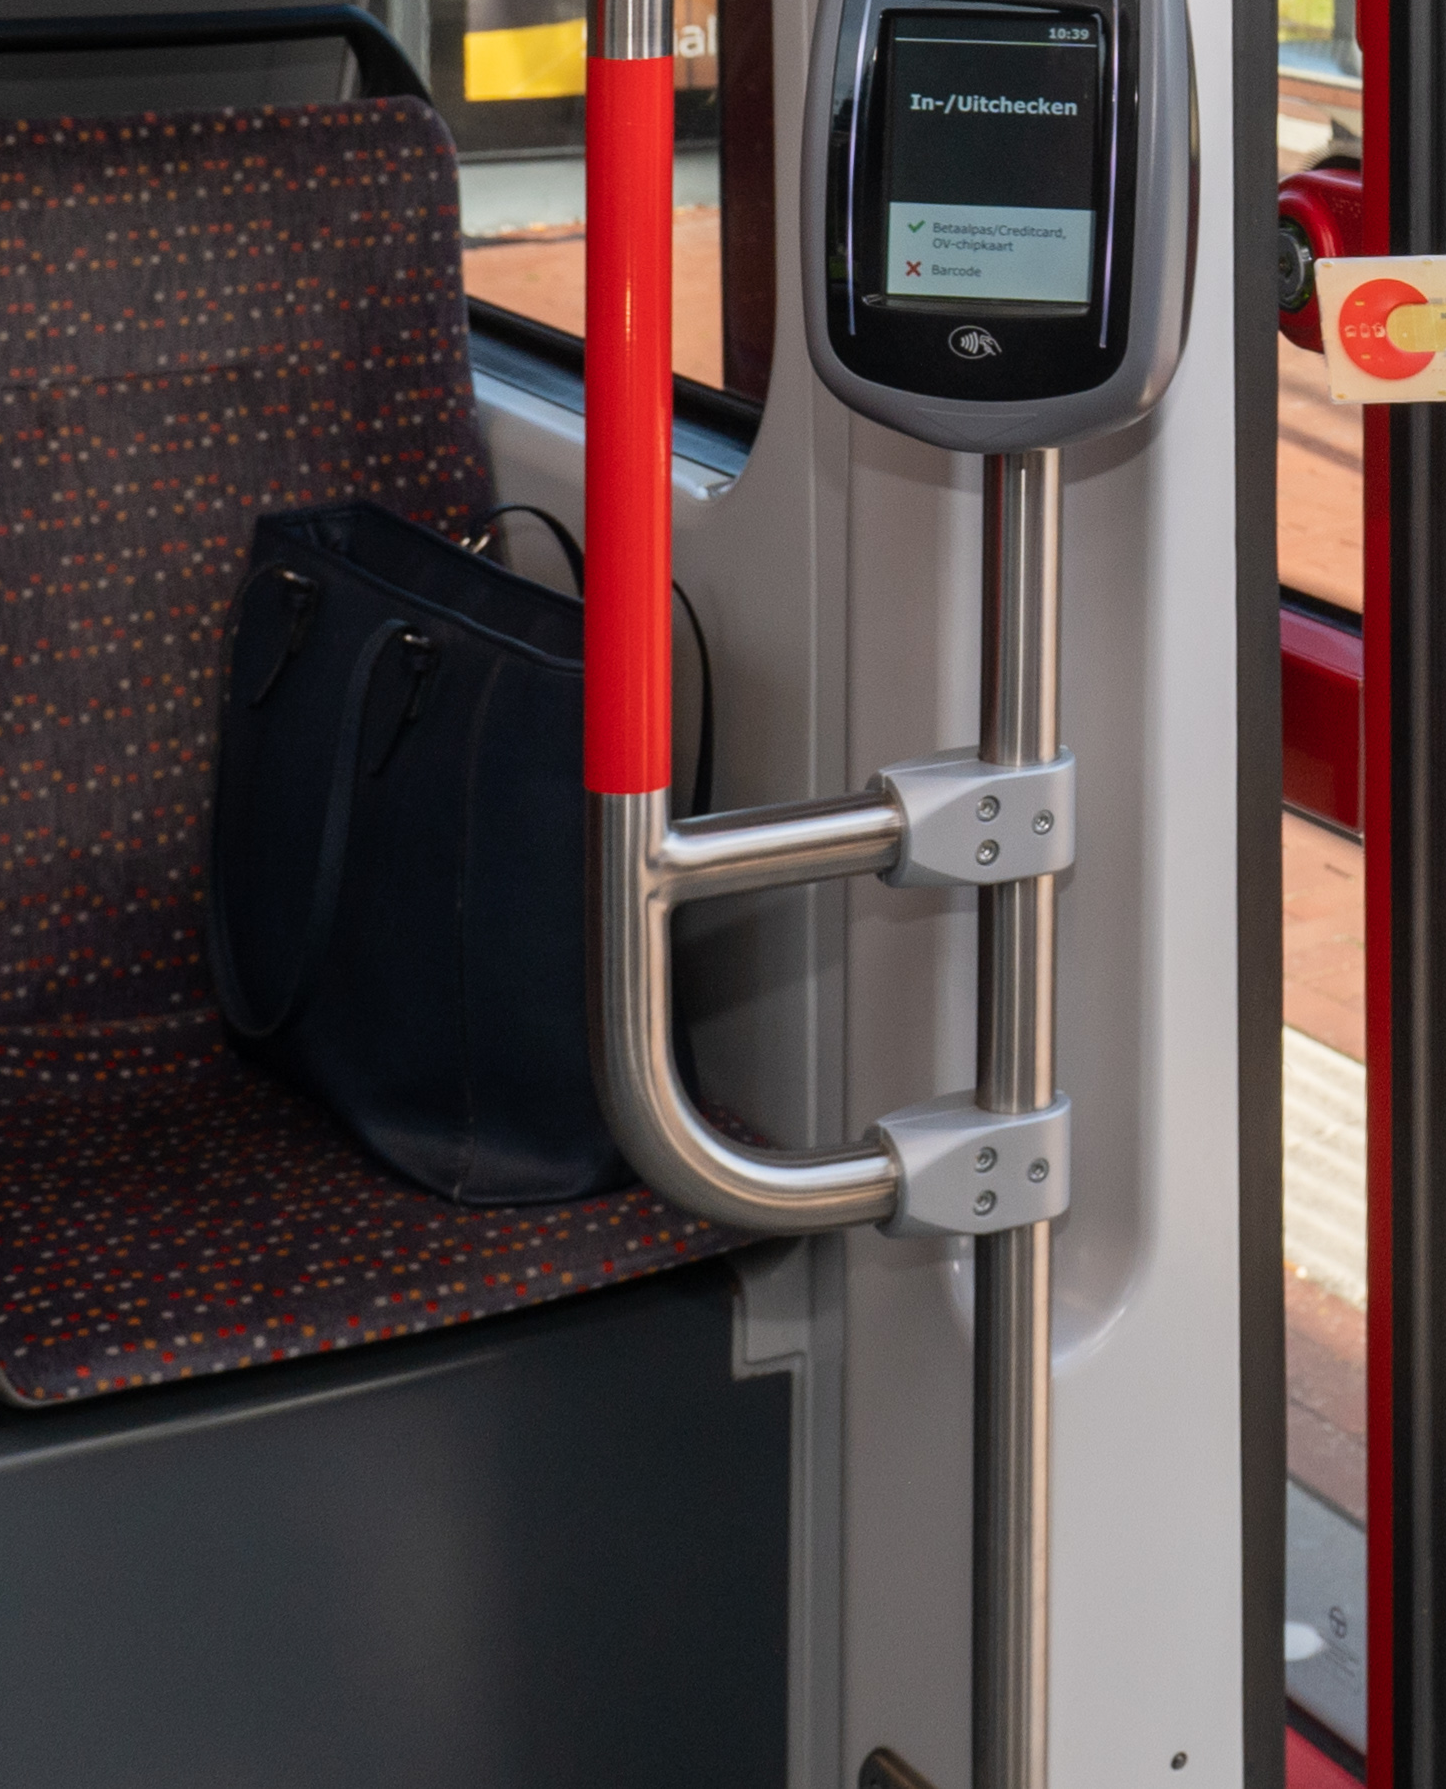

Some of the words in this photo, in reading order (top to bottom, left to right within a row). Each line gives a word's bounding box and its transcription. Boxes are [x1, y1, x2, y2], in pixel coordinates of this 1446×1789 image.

[1048, 27, 1090, 40] 10:39
[910, 93, 1078, 116] In-/Uitchecken
[933, 222, 1066, 240] Betaalpas/Creditcard,
[932, 238, 1014, 252] OV-chipkaart
[931, 264, 982, 277] Barcode
